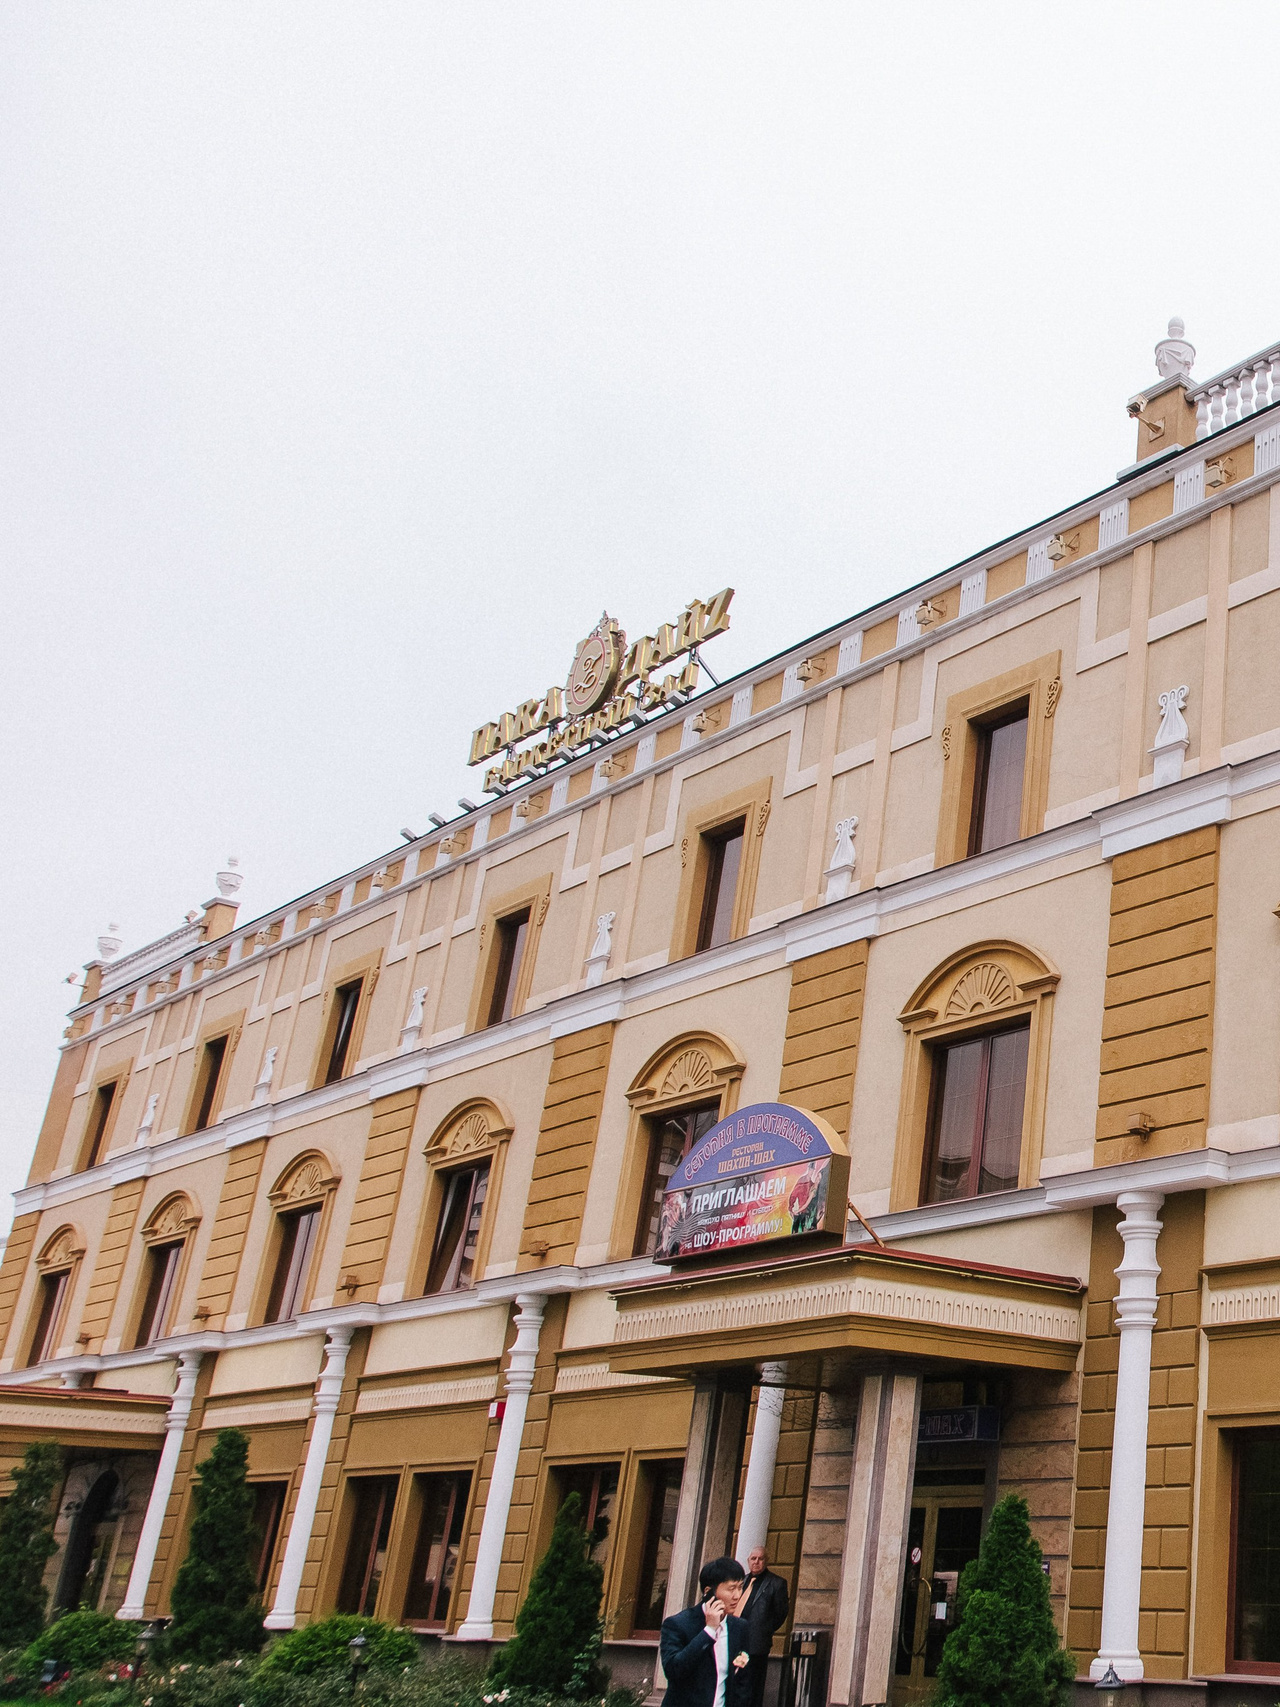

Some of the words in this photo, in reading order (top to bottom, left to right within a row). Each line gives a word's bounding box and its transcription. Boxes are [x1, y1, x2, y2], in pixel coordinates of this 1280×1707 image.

[684, 1124, 733, 1180] СЕГОДНЯ
[737, 1118, 745, 1139] В
[748, 1113, 814, 1154] ПРОГРАММЕ
[731, 1142, 764, 1157] РЕСТОРАН
[717, 1149, 775, 1174] ШАХИН-ШАХ
[691, 1176, 787, 1214] ПРИГЛАШАЕМ
[693, 1218, 783, 1247] ШОУ-ПРОГРАММУ!
